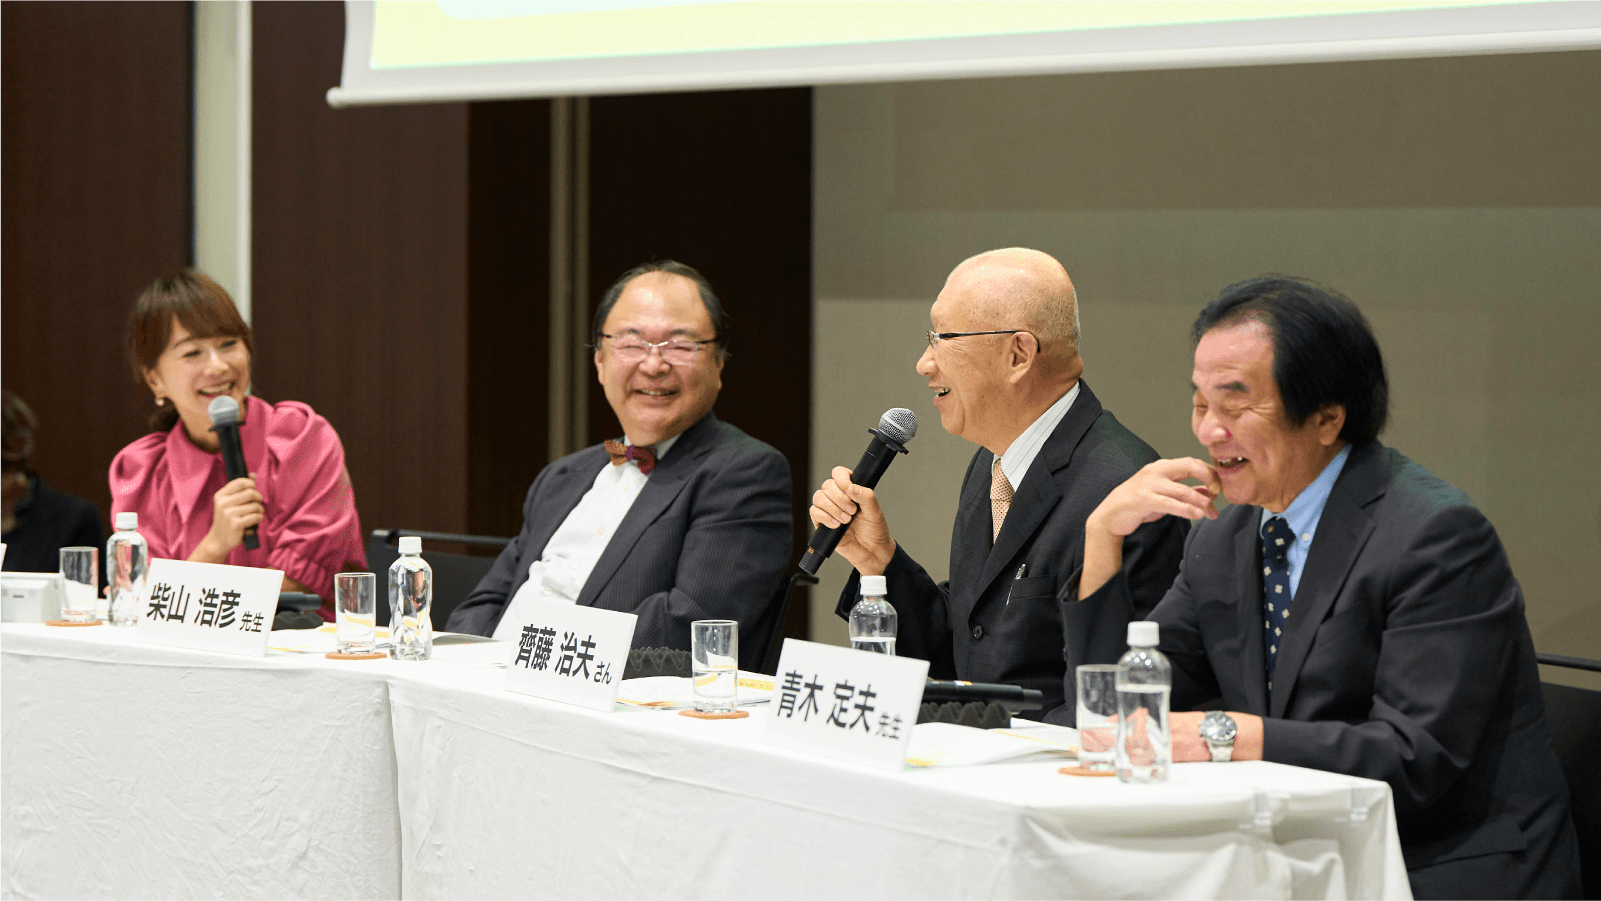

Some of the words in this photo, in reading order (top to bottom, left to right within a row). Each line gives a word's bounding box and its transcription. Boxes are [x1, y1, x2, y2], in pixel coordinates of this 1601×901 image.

[146, 582, 190, 623] 柴山
[194, 588, 241, 628] 浩彦
[239, 611, 264, 632] 先生
[554, 631, 597, 679] 治夫
[594, 661, 612, 685] さん
[777, 670, 824, 721] 青木
[826, 679, 877, 732] 定夫
[876, 713, 903, 739] 先生
